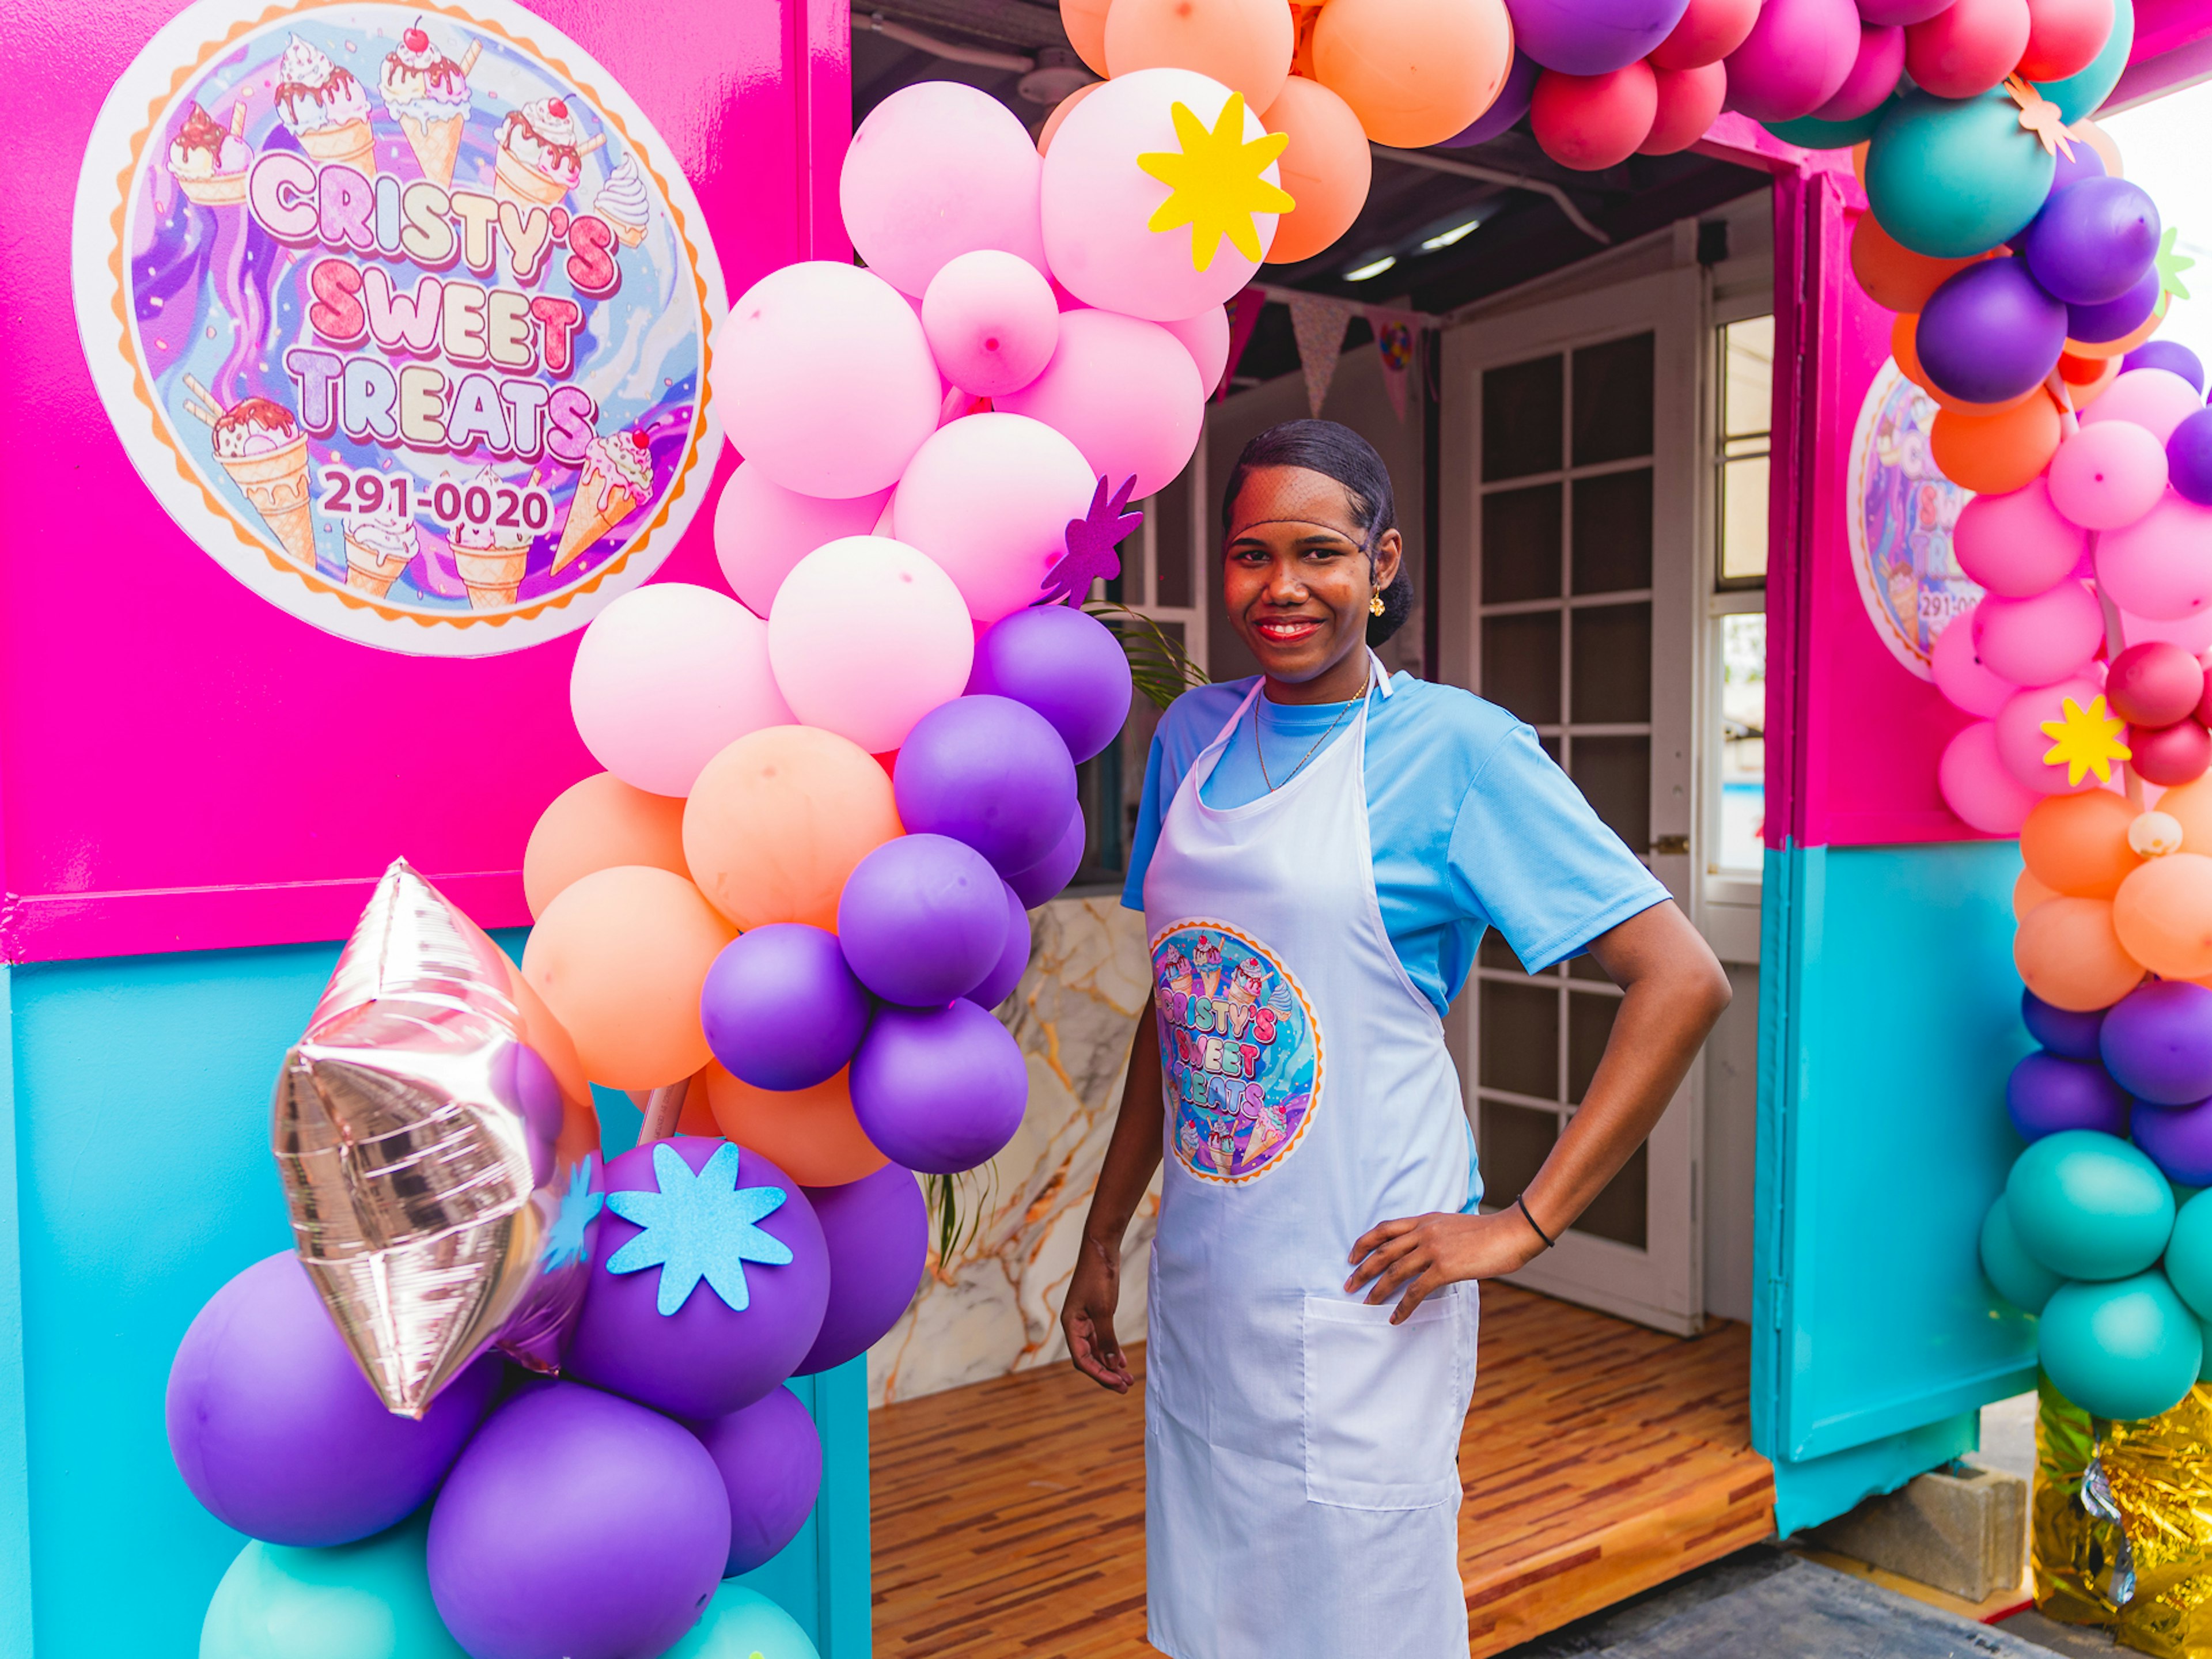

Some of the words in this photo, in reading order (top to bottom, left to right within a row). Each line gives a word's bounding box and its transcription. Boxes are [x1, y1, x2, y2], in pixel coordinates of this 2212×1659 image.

[249, 152, 616, 293] CRISTY'S
[308, 257, 582, 374] SWEET
[286, 347, 599, 463] TREATS
[323, 470, 549, 529] 291-0020
[1160, 988, 1277, 1043] CRISTY'S
[1175, 1028, 1259, 1078] SWEET
